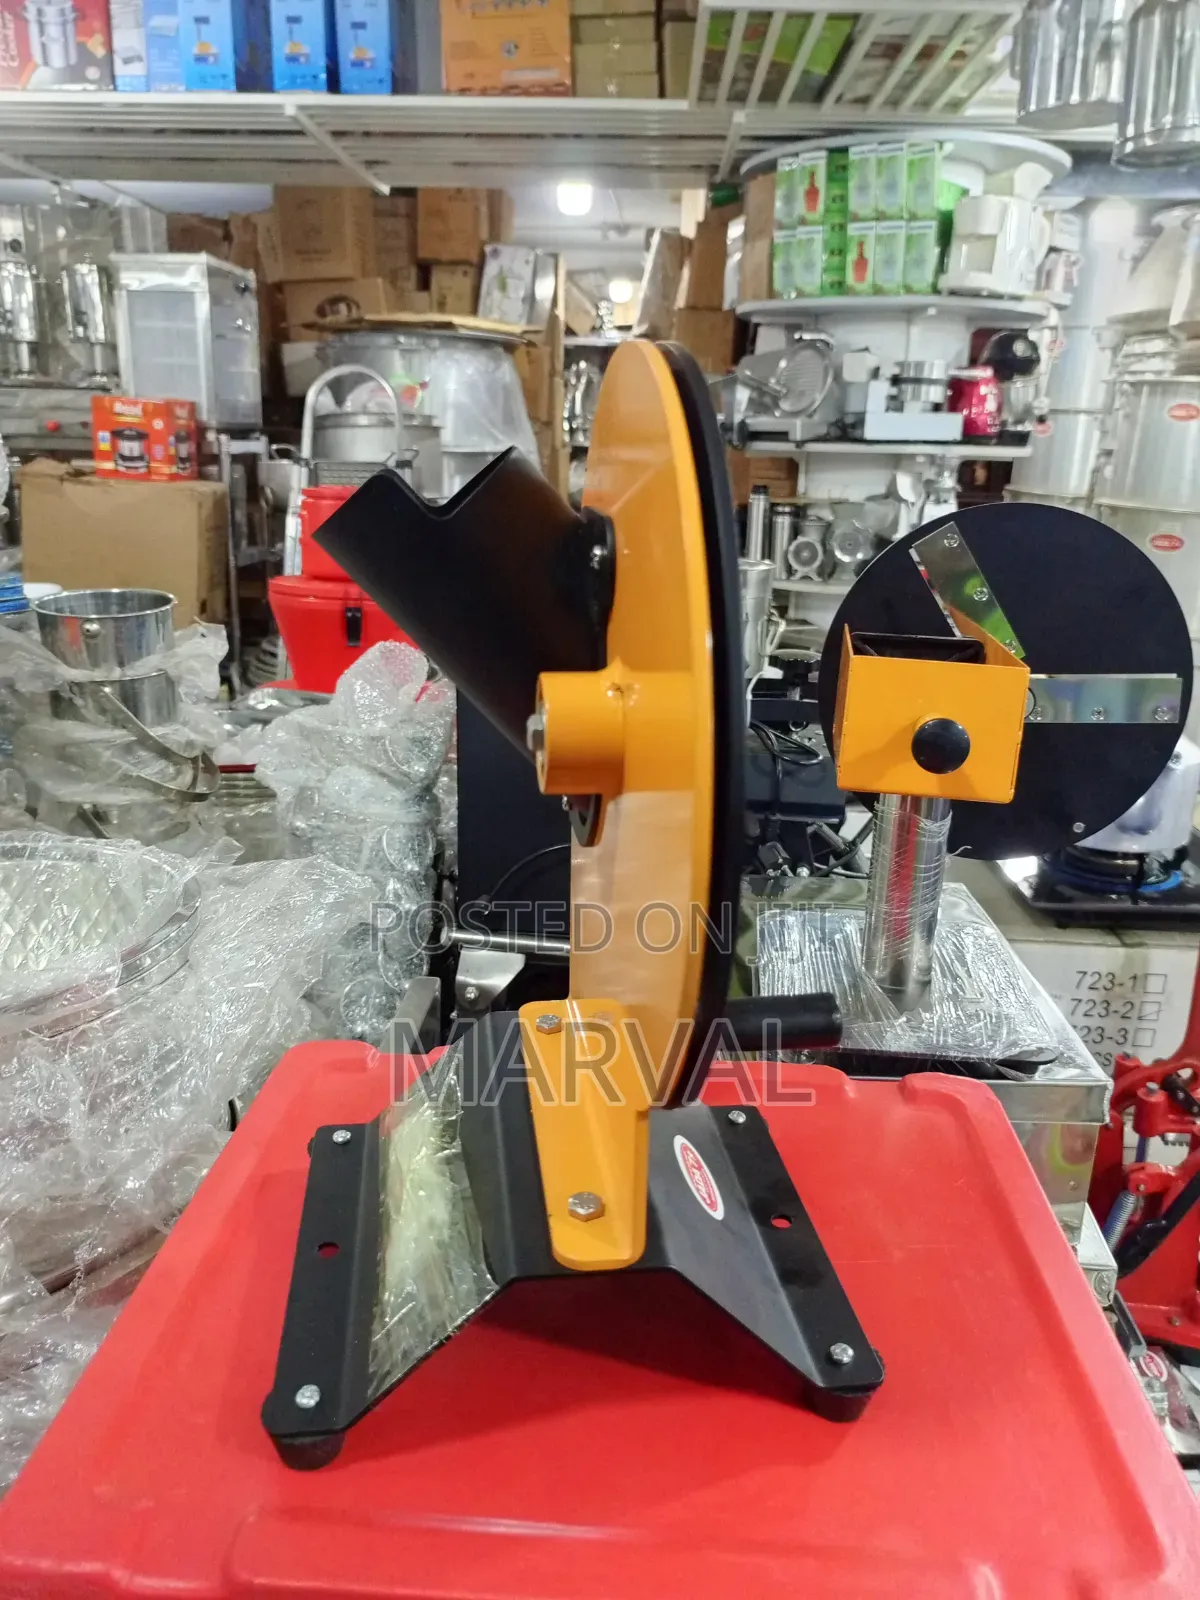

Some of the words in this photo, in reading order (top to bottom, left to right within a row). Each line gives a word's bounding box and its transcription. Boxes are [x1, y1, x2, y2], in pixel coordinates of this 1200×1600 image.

[1075, 970, 1138, 993] 723-1
[1070, 998, 1135, 1020] 723-2
[1072, 1023, 1129, 1046] 23-3
